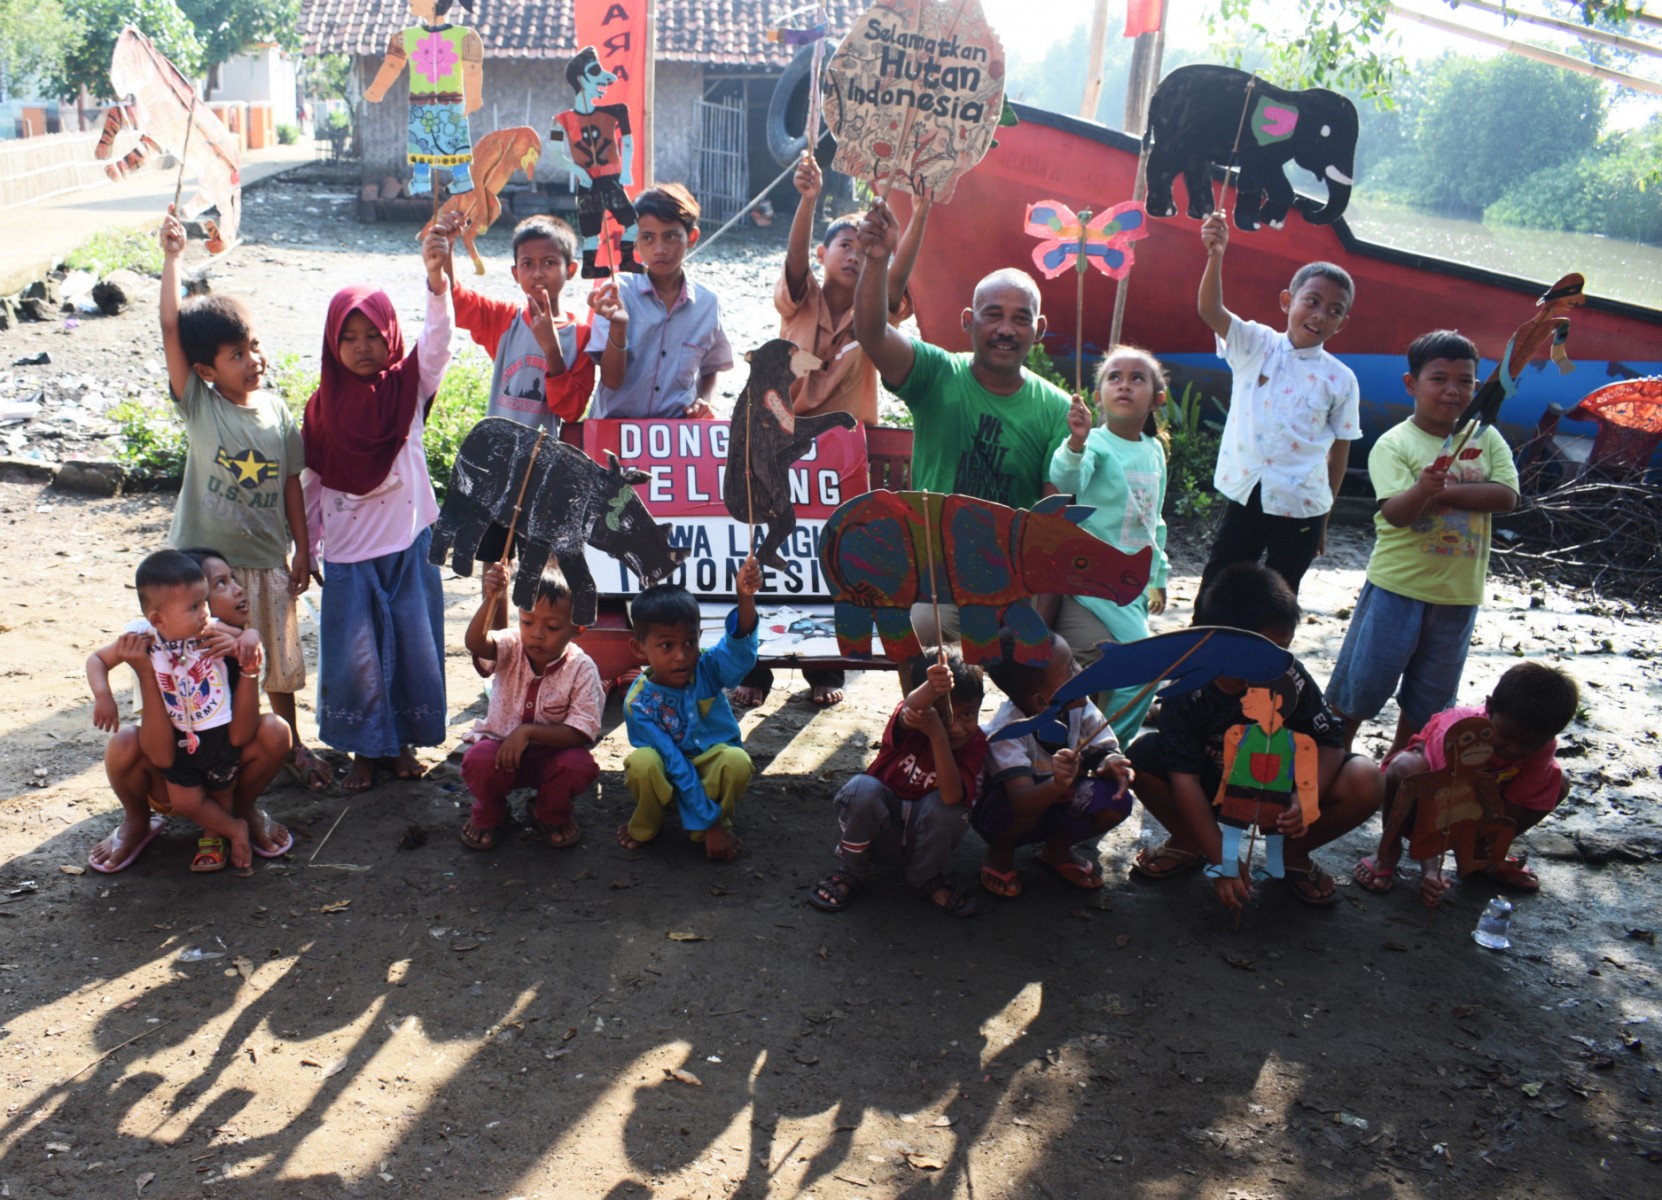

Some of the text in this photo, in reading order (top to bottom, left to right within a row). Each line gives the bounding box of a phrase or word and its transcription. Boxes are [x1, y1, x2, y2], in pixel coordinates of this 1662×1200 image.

[864, 18, 987, 63] Selamatkan
[880, 46, 981, 92] Hutan
[848, 78, 984, 123] Indonesia
[168, 710, 183, 722] US
